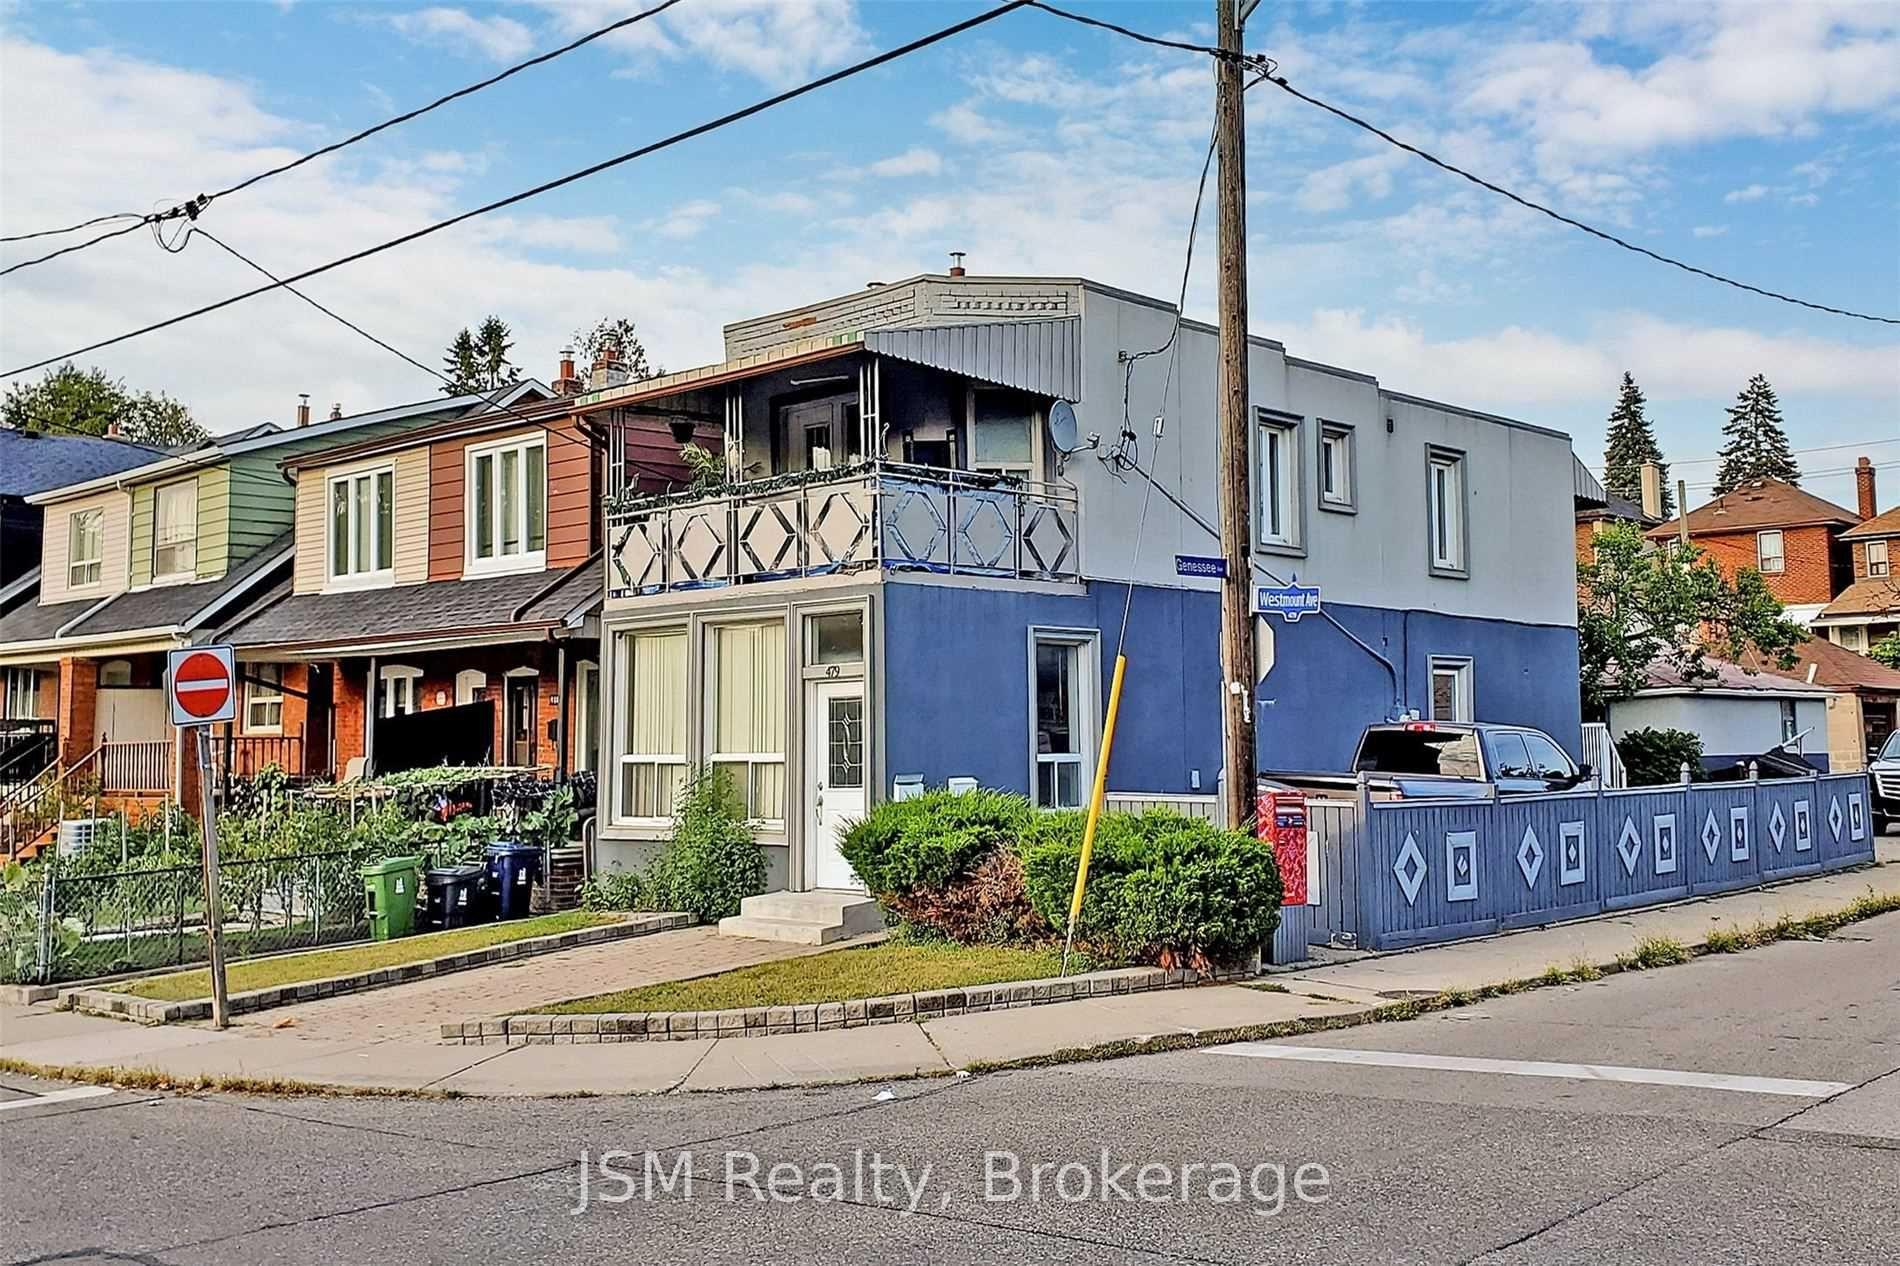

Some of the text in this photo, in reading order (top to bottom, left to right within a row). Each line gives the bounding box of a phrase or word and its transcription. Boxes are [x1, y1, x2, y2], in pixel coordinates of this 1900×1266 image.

[1176, 557, 1217, 574] Genessee
[1259, 591, 1318, 608] Westmount Ave
[826, 665, 840, 679] 479
